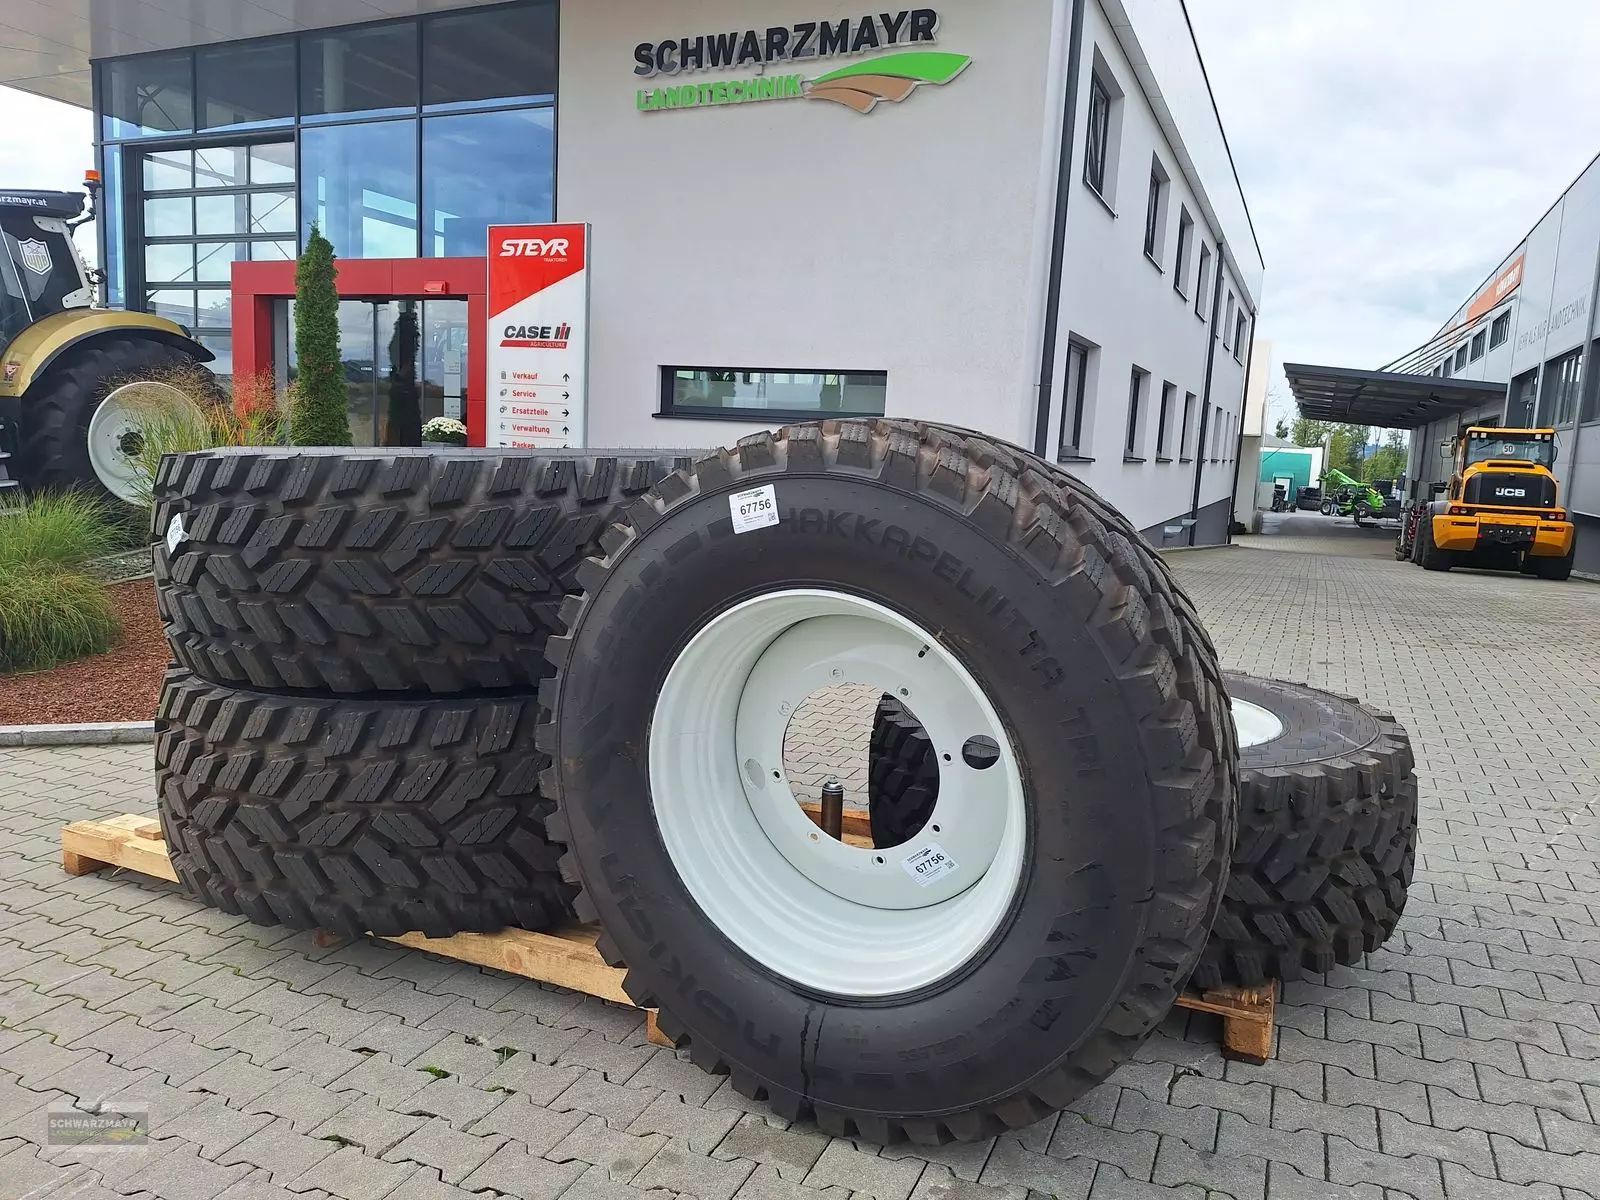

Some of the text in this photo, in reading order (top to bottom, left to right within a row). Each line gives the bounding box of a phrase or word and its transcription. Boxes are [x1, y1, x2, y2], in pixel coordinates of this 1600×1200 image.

[633, 8, 938, 75] SCHWARZMAYR
[637, 74, 802, 110] LANDTECHNIK
[0, 196, 47, 206] rzmayr.at
[499, 238, 569, 256] STEYR
[504, 326, 551, 339] CASE
[512, 372, 538, 380] Verkauf
[512, 407, 549, 416] Ersatzteile
[512, 424, 550, 434] Verwaltung
[1503, 445, 1514, 453] 50
[1496, 488, 1526, 497] JCB
[740, 498, 771, 515] 67756
[915, 853, 945, 873] 67756
